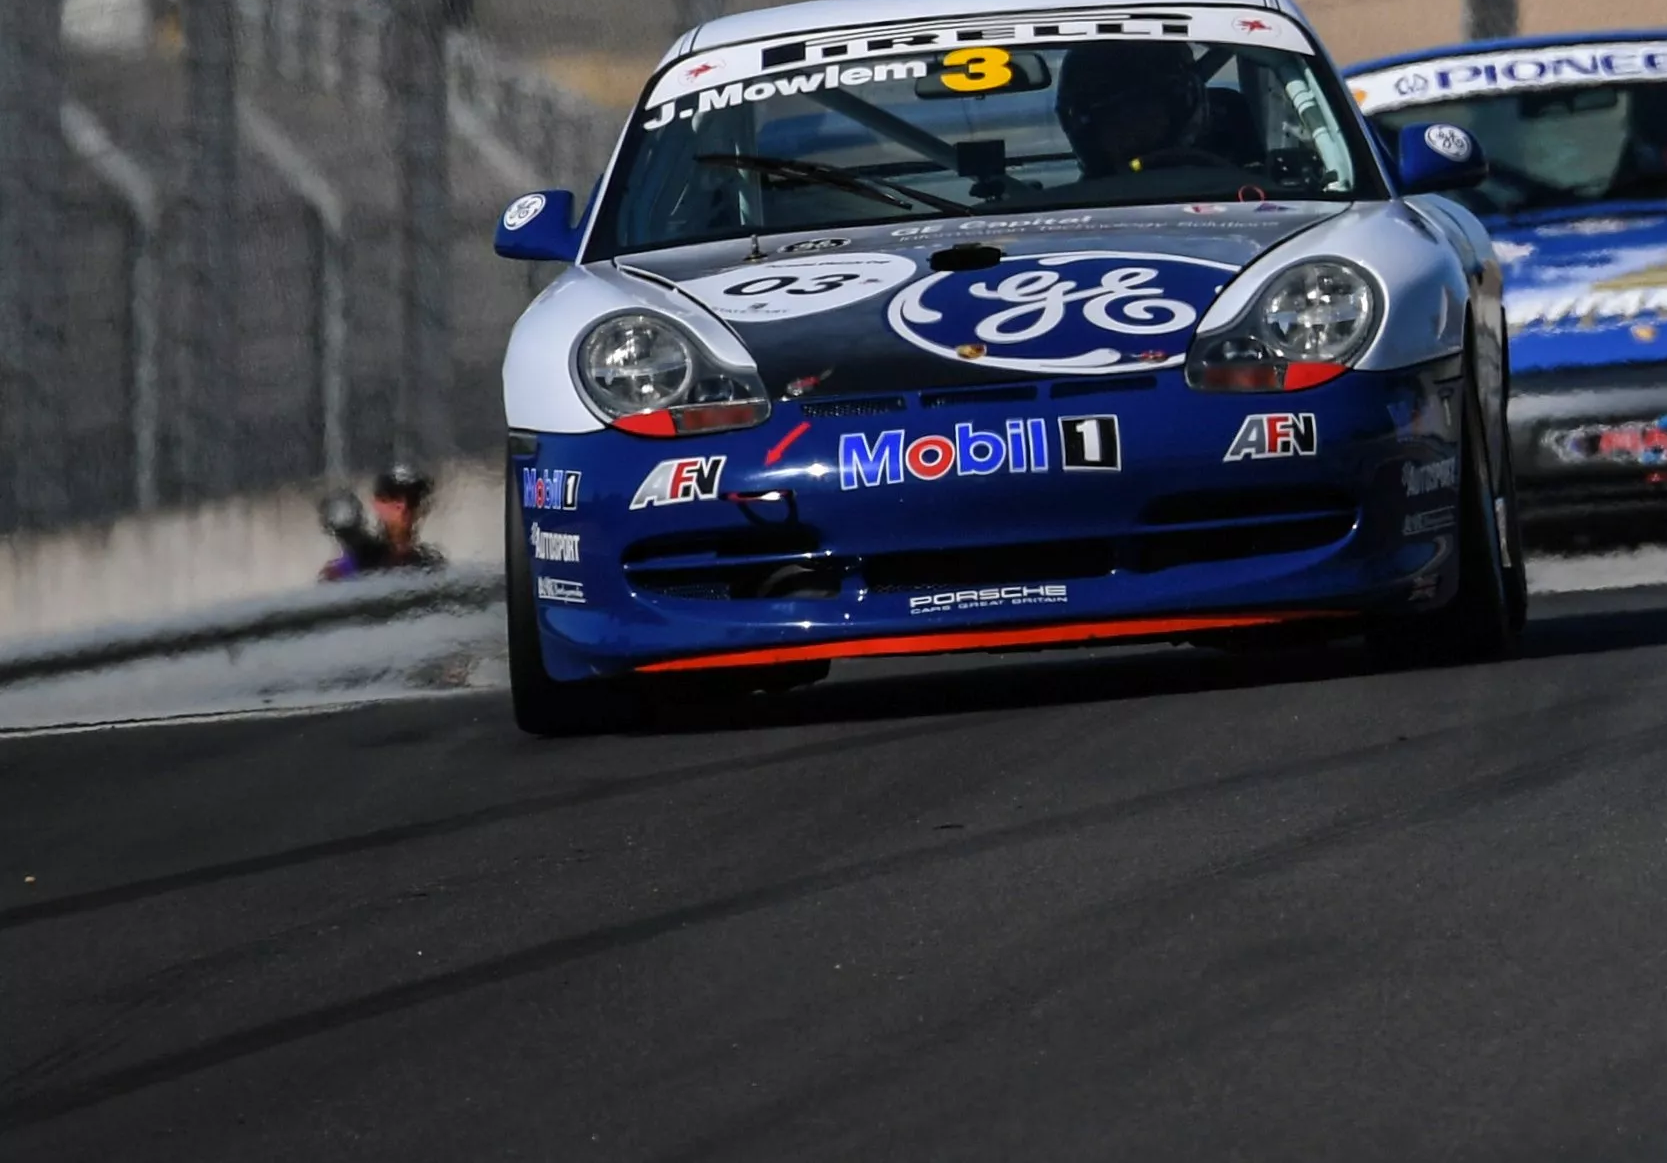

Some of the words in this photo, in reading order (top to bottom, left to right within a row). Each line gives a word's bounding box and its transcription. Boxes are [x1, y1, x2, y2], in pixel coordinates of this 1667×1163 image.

[940, 47, 1013, 93] 3
[957, 213, 1094, 232] Capital
[722, 272, 861, 297] 03
[968, 266, 1198, 344] GE
[838, 416, 1049, 491] Mobil
[1066, 416, 1112, 468] 1
[1223, 412, 1318, 463] AFN
[523, 467, 563, 510] Mobil
[564, 472, 580, 508] 1
[628, 454, 727, 511] AFN
[909, 585, 1067, 608] PORSCHE
[910, 604, 951, 615] CARS
[958, 600, 1003, 609] GREAT
[1011, 596, 1068, 605] BRITAIN
